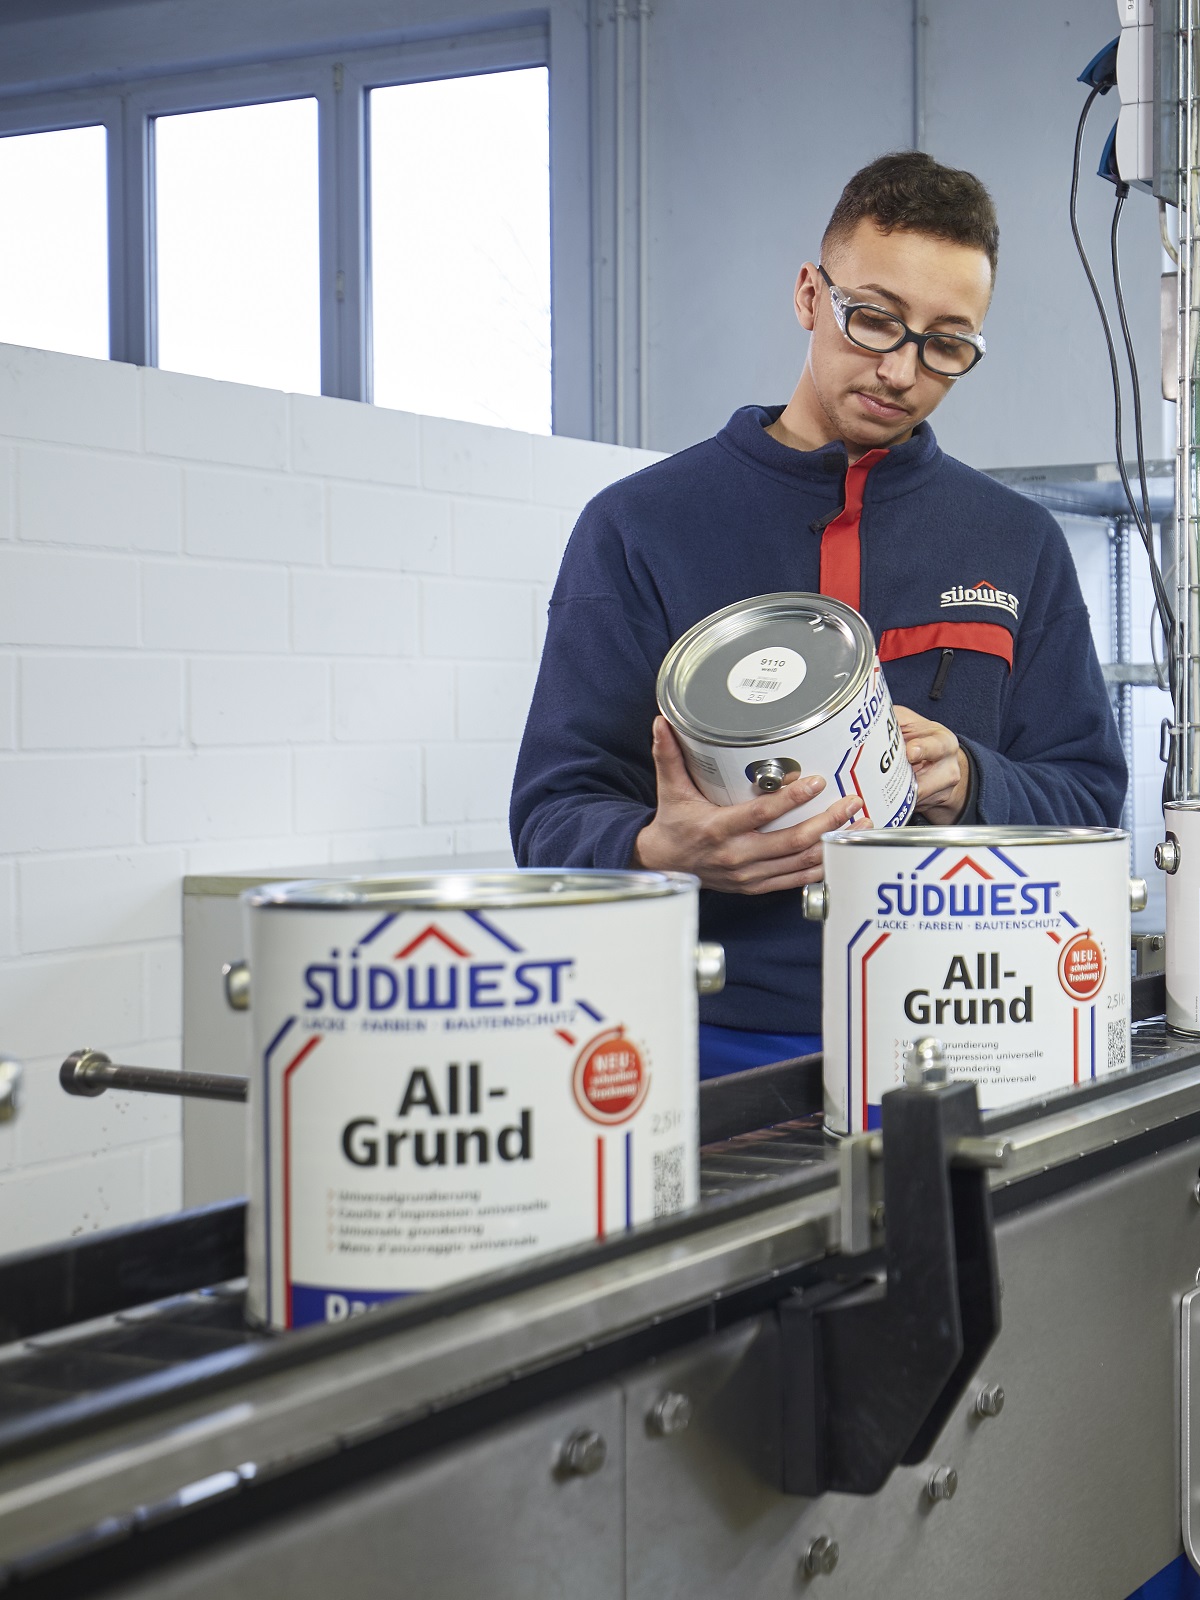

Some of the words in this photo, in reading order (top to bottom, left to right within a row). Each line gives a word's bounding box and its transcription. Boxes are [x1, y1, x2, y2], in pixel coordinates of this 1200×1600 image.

[940, 585, 1019, 612] SÜDWEST
[760, 658, 786, 667] 9110
[854, 729, 871, 748] LACKE
[877, 871, 1060, 917] SÜDWEST
[877, 919, 909, 930] LACKE
[919, 920, 963, 931] FARBEN
[975, 918, 1062, 931] BAUTENSCHUTZ
[1072, 949, 1097, 963] NEU:
[942, 951, 1017, 990] All-
[1070, 962, 1099, 973] schnellere
[304, 947, 575, 1011] SÜDWEST
[1069, 971, 1100, 983] Trocknung!
[904, 986, 1034, 1025] Grund
[302, 1016, 346, 1032] LACKE
[361, 1017, 428, 1033] FARBEN
[444, 1010, 577, 1032] BAUTENSCHUTZ
[594, 1051, 636, 1072] NEU:
[996, 1050, 1044, 1060] universelle
[949, 1064, 1001, 1074] grondering
[991, 1074, 1037, 1084] universale
[397, 1062, 507, 1118] All-
[341, 1109, 532, 1168] Grund
[338, 1189, 482, 1205] Universalgrundierung
[476, 1199, 550, 1216] universelle
[408, 1223, 485, 1239] grondering
